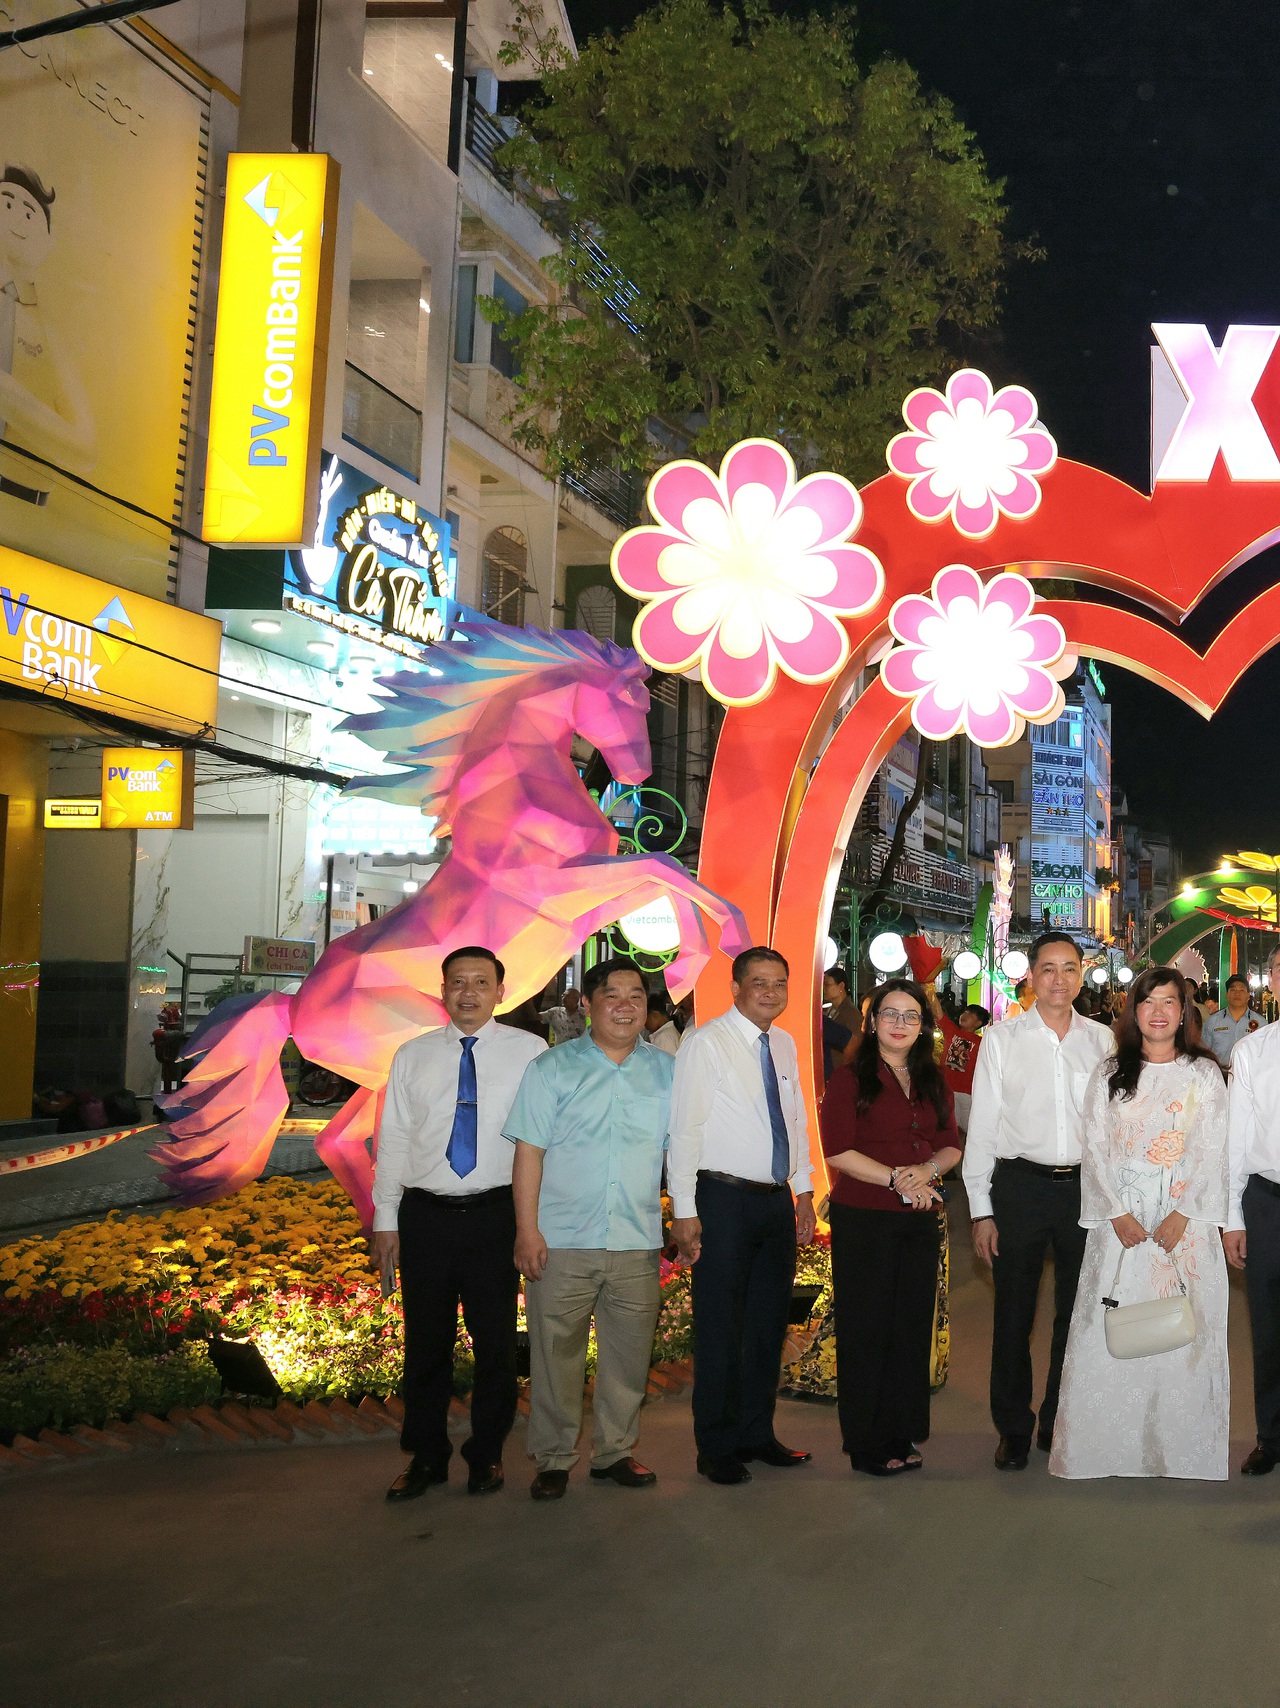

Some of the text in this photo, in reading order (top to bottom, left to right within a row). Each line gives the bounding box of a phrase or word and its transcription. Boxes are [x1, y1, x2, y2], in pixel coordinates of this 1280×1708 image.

[248, 229, 304, 467] PVcomBank
[0, 586, 92, 657] Vcom
[22, 641, 103, 696] Bank
[108, 767, 156, 781] PVcom
[1034, 769, 1083, 789] SÀI GÒN
[127, 780, 163, 792] Bank
[144, 811, 173, 822] ATM
[626, 914, 678, 924] Vietcomba
